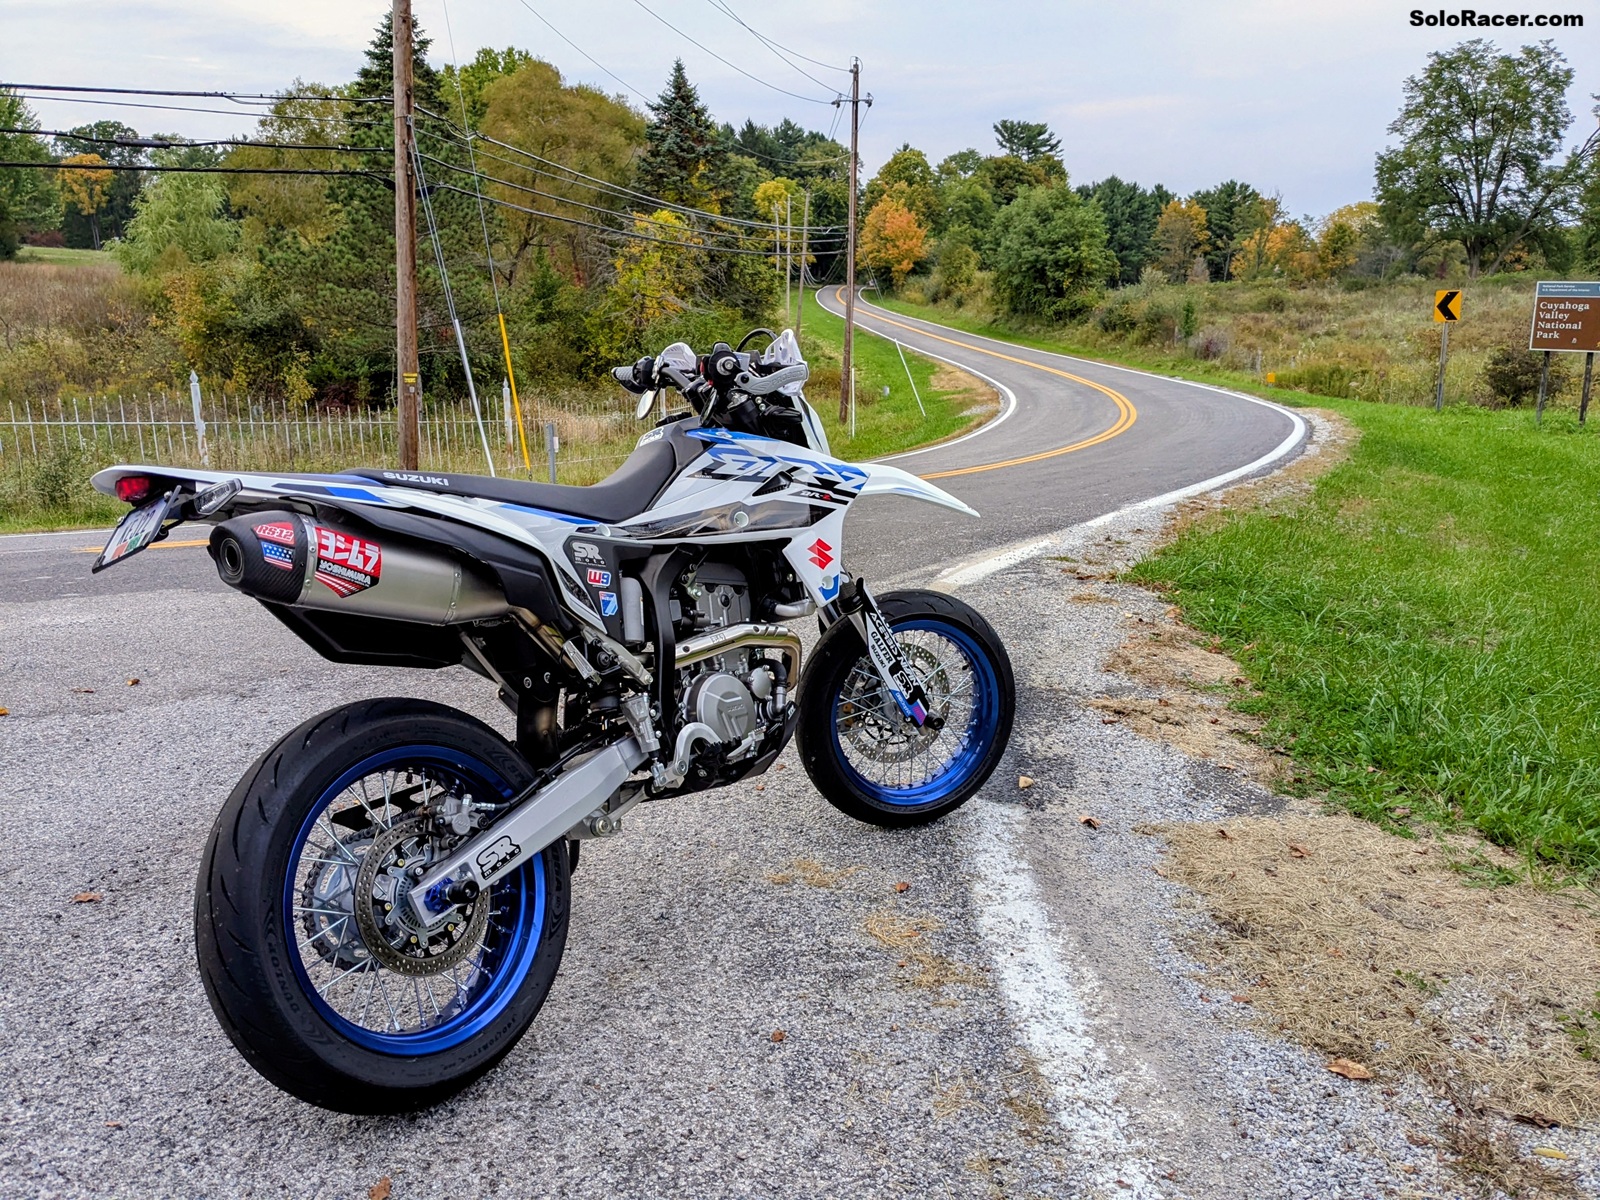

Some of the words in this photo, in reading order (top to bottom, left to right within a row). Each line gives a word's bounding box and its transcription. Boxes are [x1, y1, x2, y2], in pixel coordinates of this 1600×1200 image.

[1539, 311, 1570, 321] Valley
[1540, 301, 1590, 312] Cuyahoga
[1536, 331, 1560, 339] Park
[1537, 321, 1582, 330] National
[382, 471, 449, 486] SUZUKI
[572, 541, 603, 560] SR
[319, 559, 371, 585] YOSHIMURA
[869, 612, 899, 655] ACERBIS
[870, 631, 892, 664] GALFER
[870, 645, 887, 669] SUZUKI
[476, 835, 521, 872] SR
